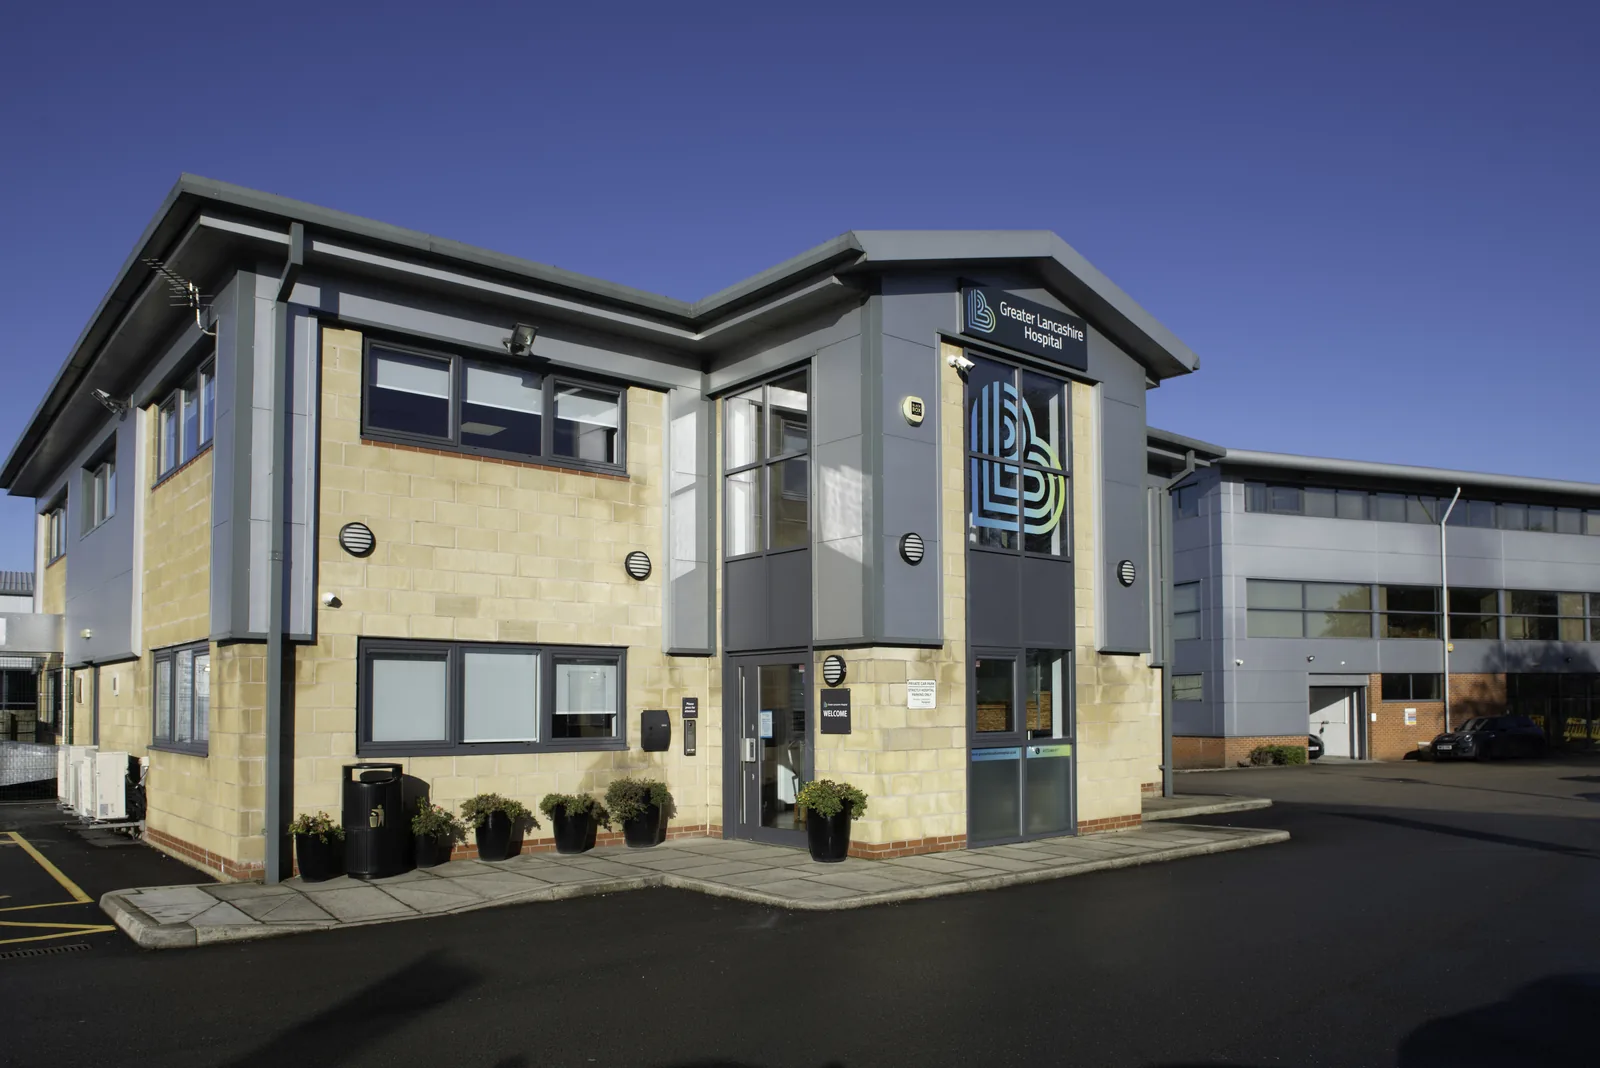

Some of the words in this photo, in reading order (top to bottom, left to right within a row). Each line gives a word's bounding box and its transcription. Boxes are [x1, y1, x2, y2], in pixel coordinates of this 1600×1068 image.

[1000, 301, 1036, 325] Greater
[1037, 313, 1084, 342] Lancashire
[1024, 326, 1063, 350] Hospital
